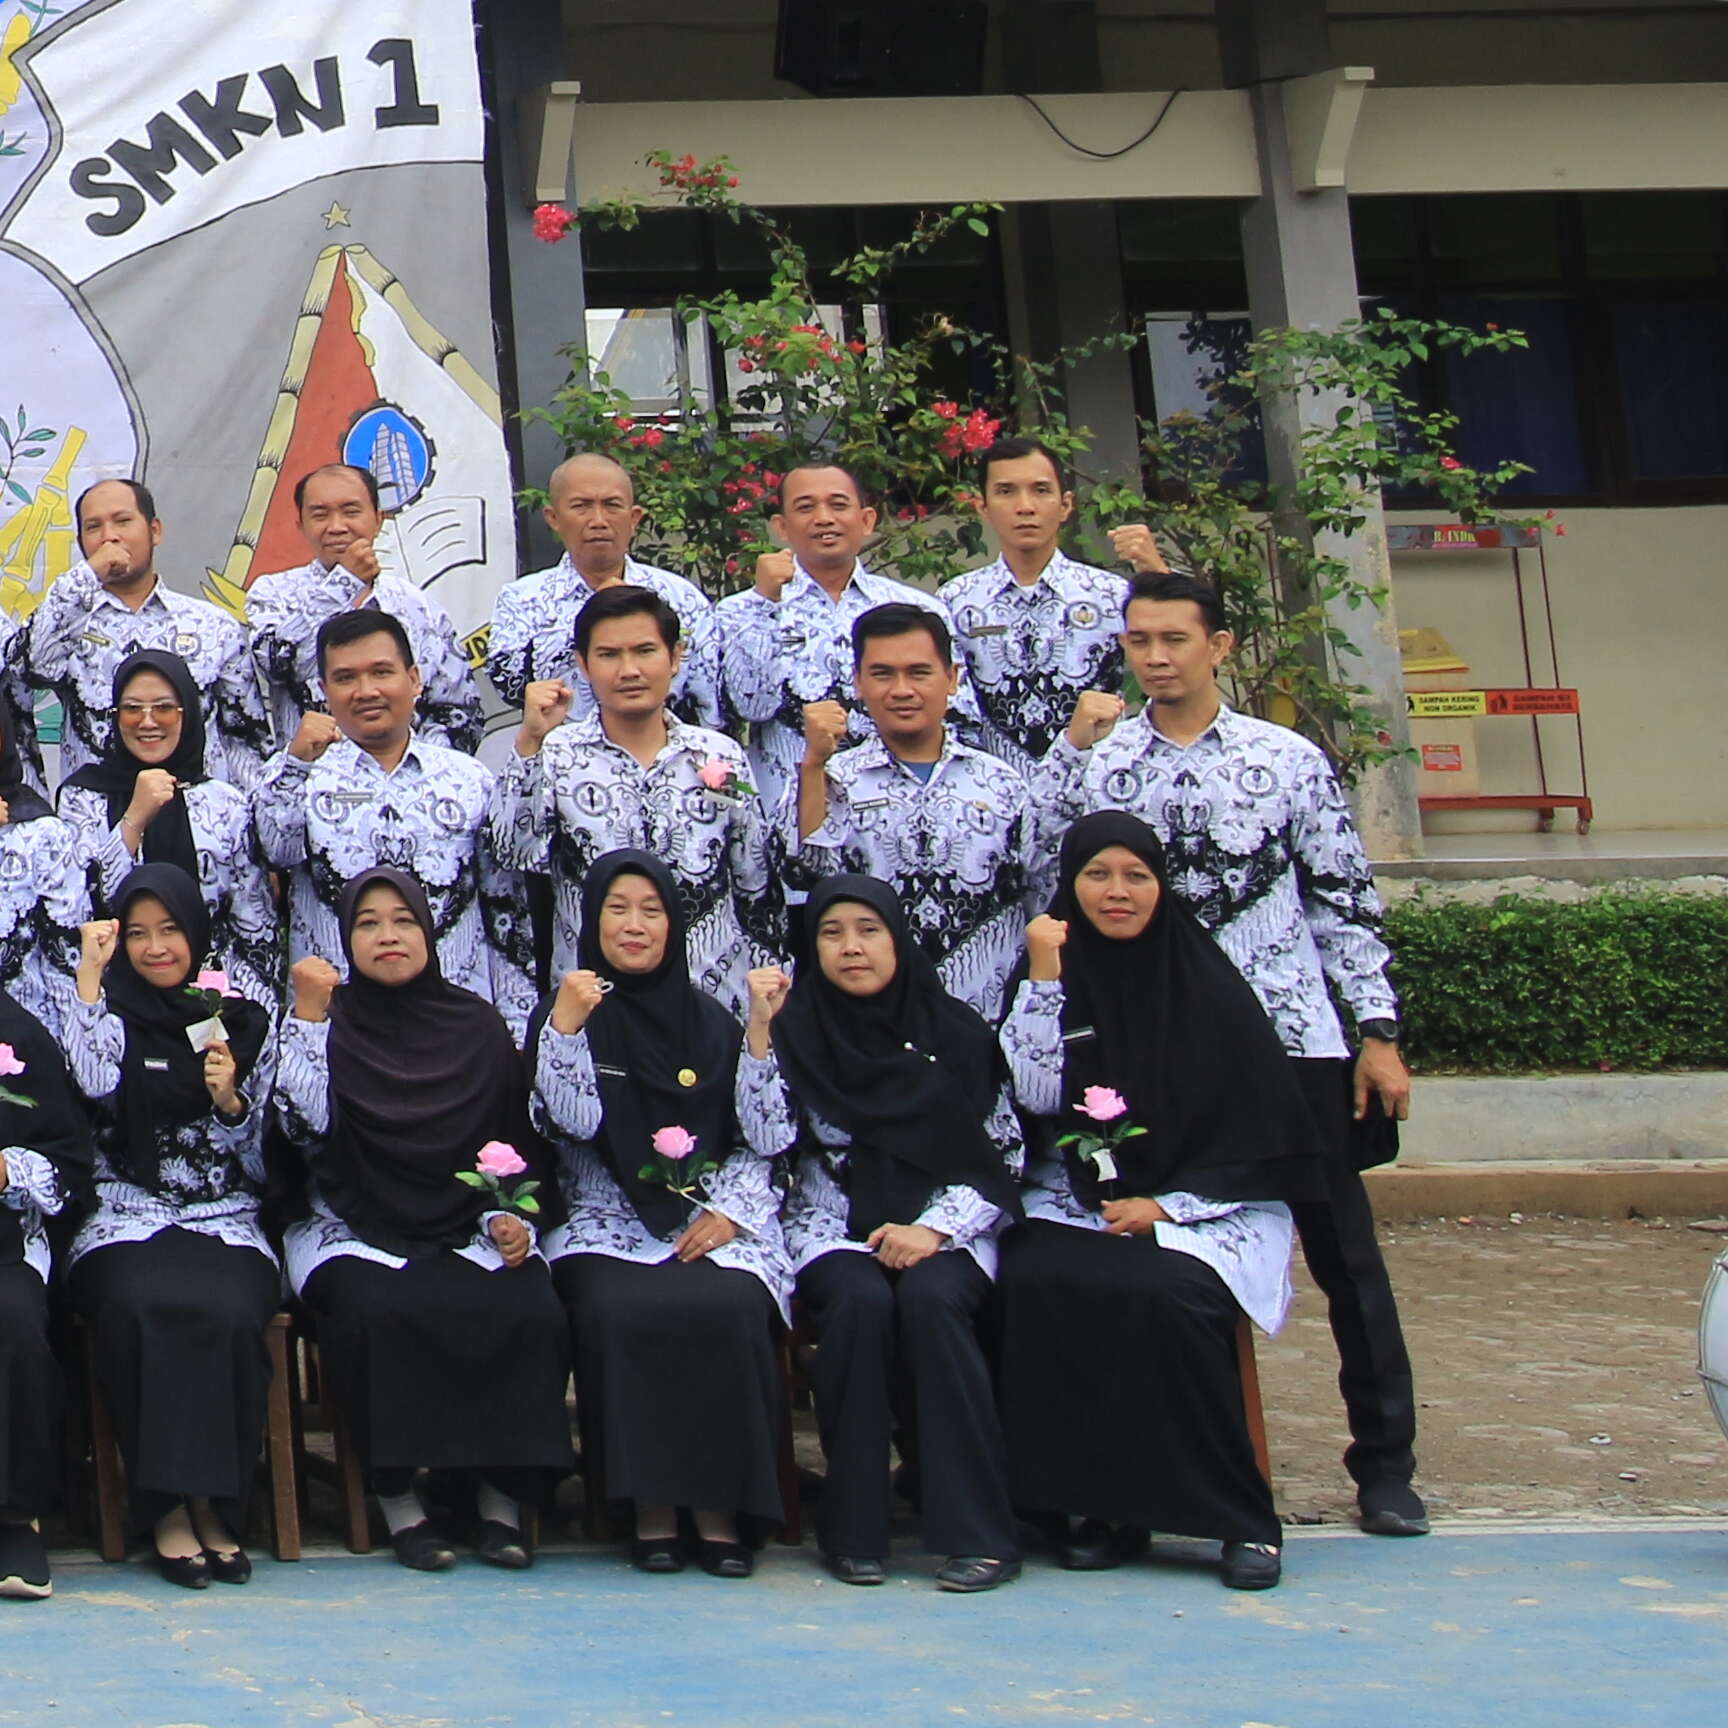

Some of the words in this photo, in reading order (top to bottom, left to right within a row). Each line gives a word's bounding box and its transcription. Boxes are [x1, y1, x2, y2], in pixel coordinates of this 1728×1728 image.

[69, 55, 346, 237] SMKN
[365, 38, 440, 130] 1
[1419, 695, 1449, 703] SAMPAH
[1451, 695, 1480, 703] KERING
[1424, 704, 1440, 712] NON
[1443, 704, 1477, 712] ORGANIK
